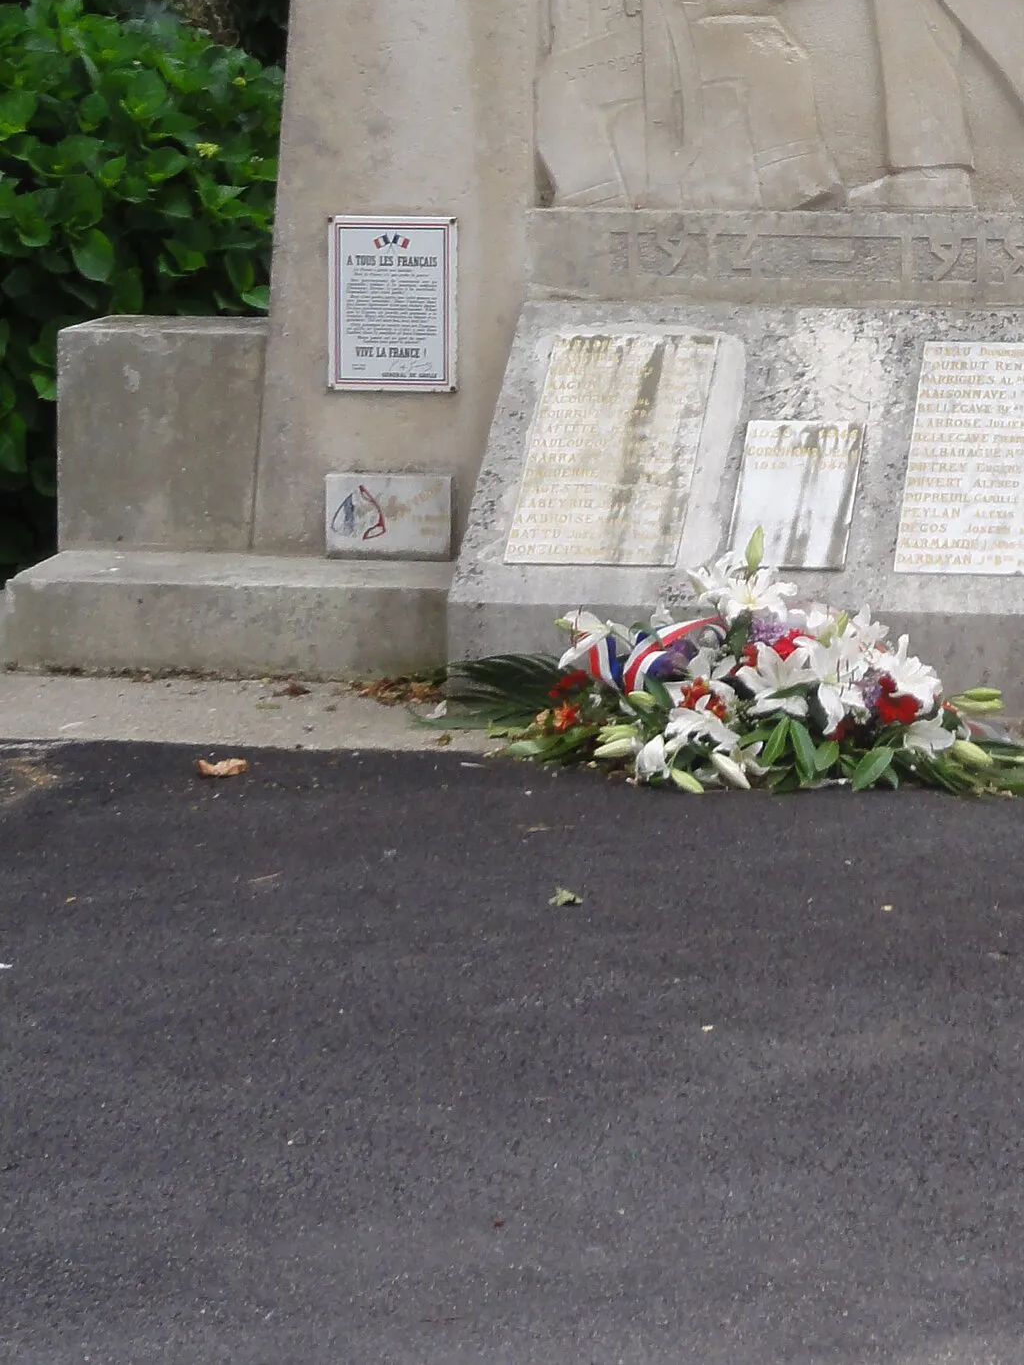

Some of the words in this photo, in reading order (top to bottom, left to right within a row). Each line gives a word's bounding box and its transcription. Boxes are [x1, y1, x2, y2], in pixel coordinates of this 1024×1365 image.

[346, 255, 353, 266] A
[355, 255, 376, 266] TOUS
[380, 256, 393, 266] LES
[397, 256, 438, 268] FRANÇAIS
[355, 346, 373, 357] VIVE
[376, 347, 387, 358] LA
[389, 347, 420, 358] FRANCE
